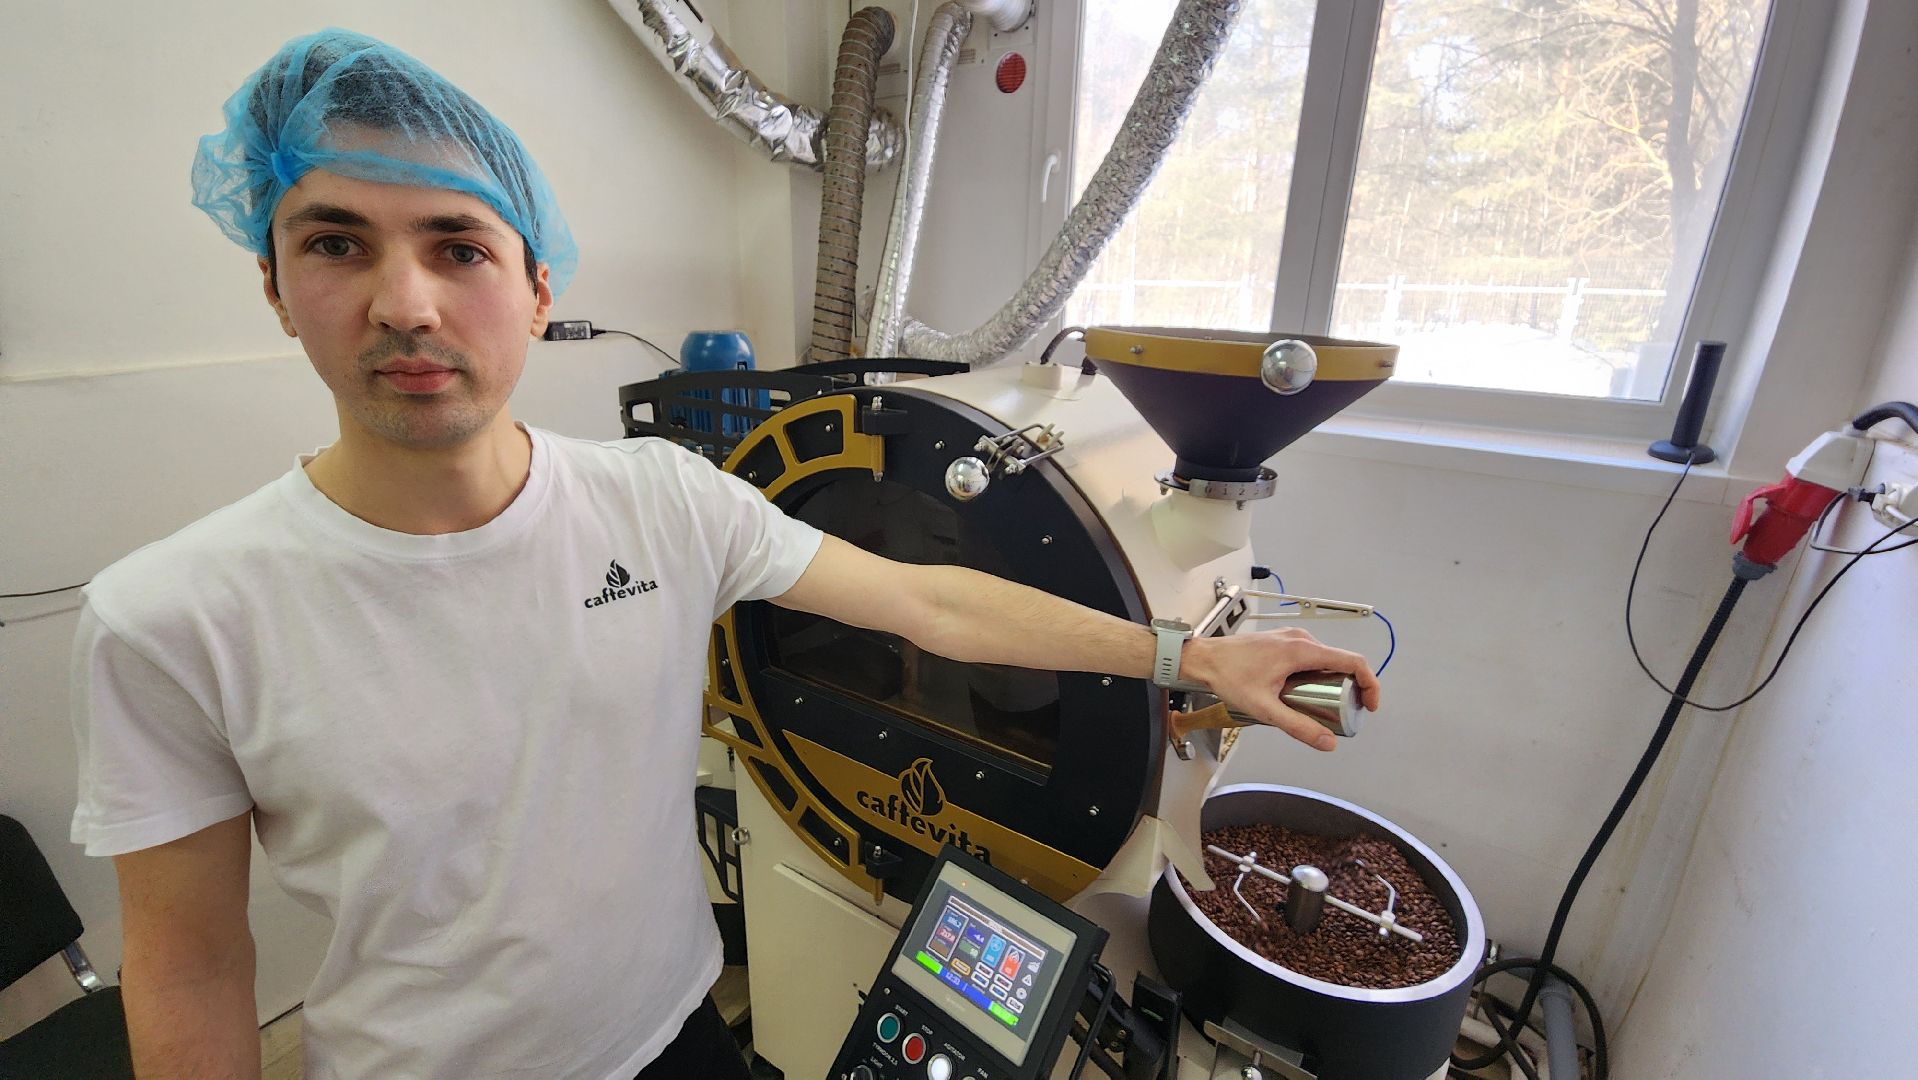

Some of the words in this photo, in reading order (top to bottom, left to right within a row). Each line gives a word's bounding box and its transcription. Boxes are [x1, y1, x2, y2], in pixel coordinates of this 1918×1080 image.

[895, 1004, 908, 1016] START
[921, 1025, 934, 1035] STOP
[977, 1067, 988, 1079] FAN
